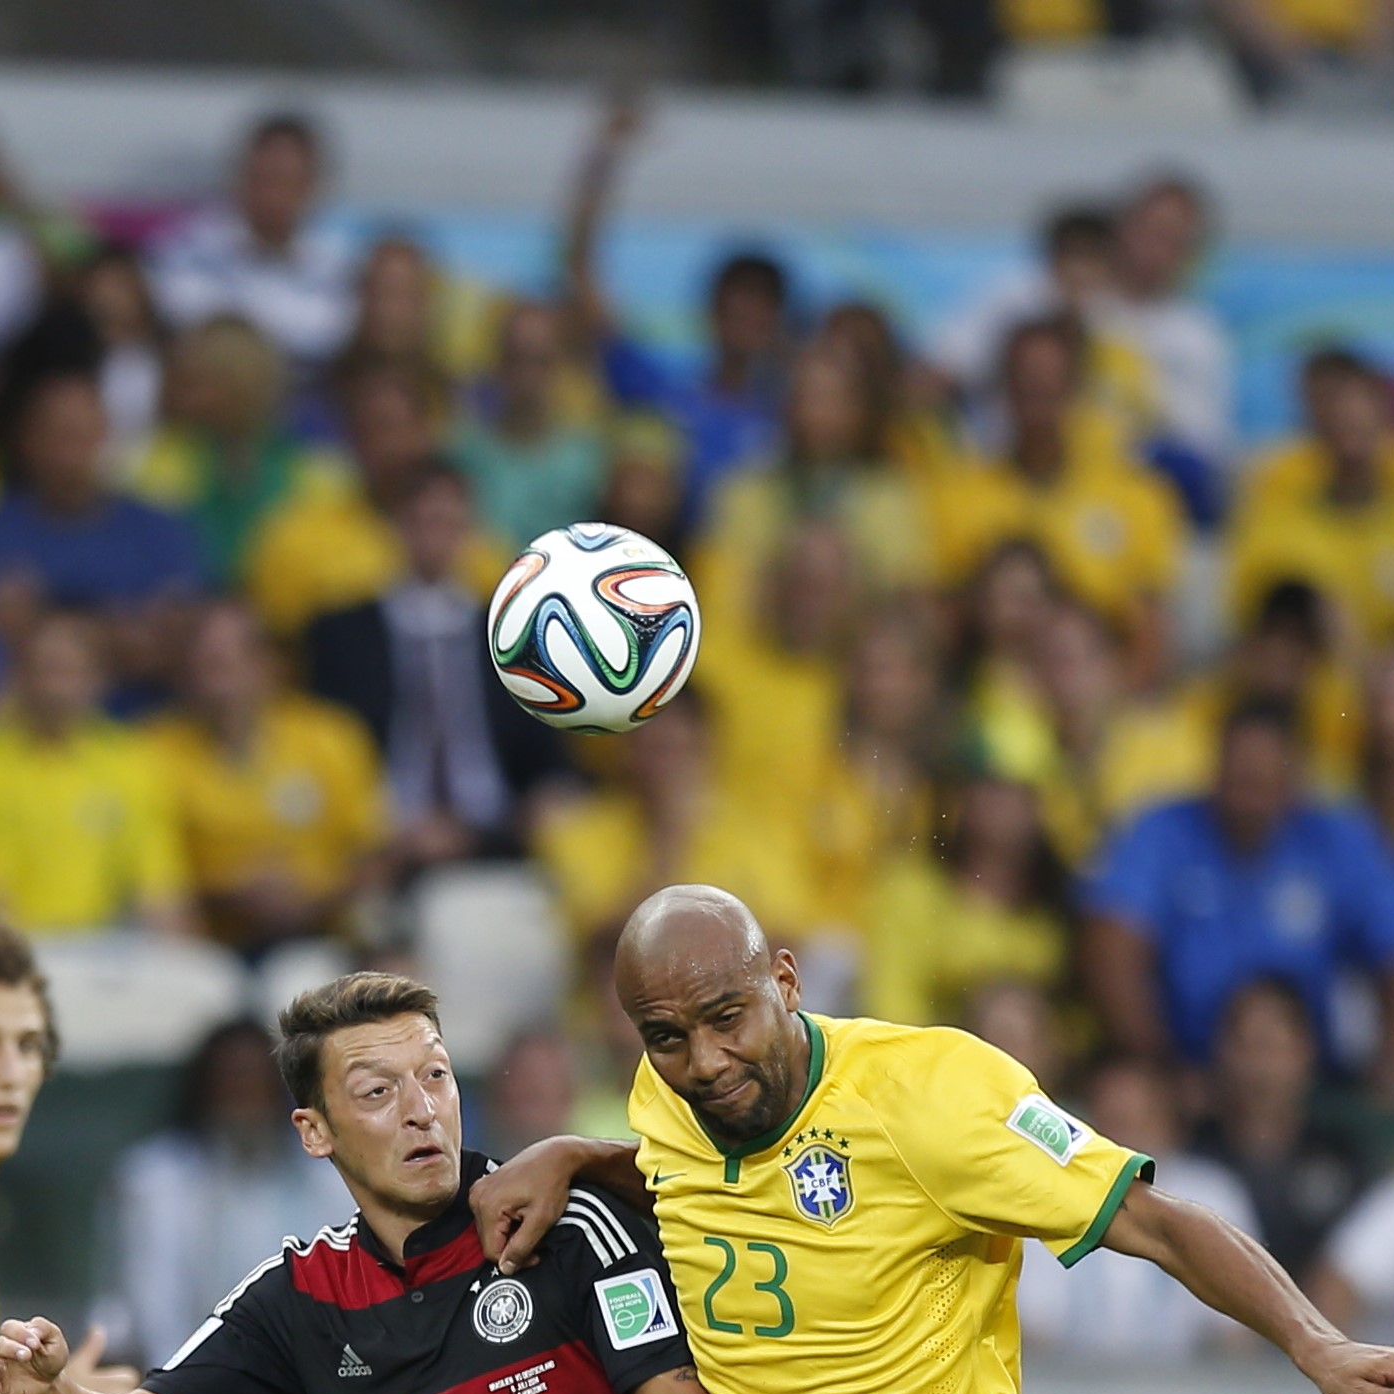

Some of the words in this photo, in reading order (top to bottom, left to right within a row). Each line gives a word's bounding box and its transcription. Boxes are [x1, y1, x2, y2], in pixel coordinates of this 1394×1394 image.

[810, 1177, 832, 1189] CBF
[703, 1236, 795, 1337] 23
[608, 1291, 642, 1305] FOOTBALL
[610, 1303, 624, 1311] FOR
[625, 1298, 642, 1307] HOPE
[649, 1322, 666, 1332] FIFA
[337, 1365, 373, 1377] adidas
